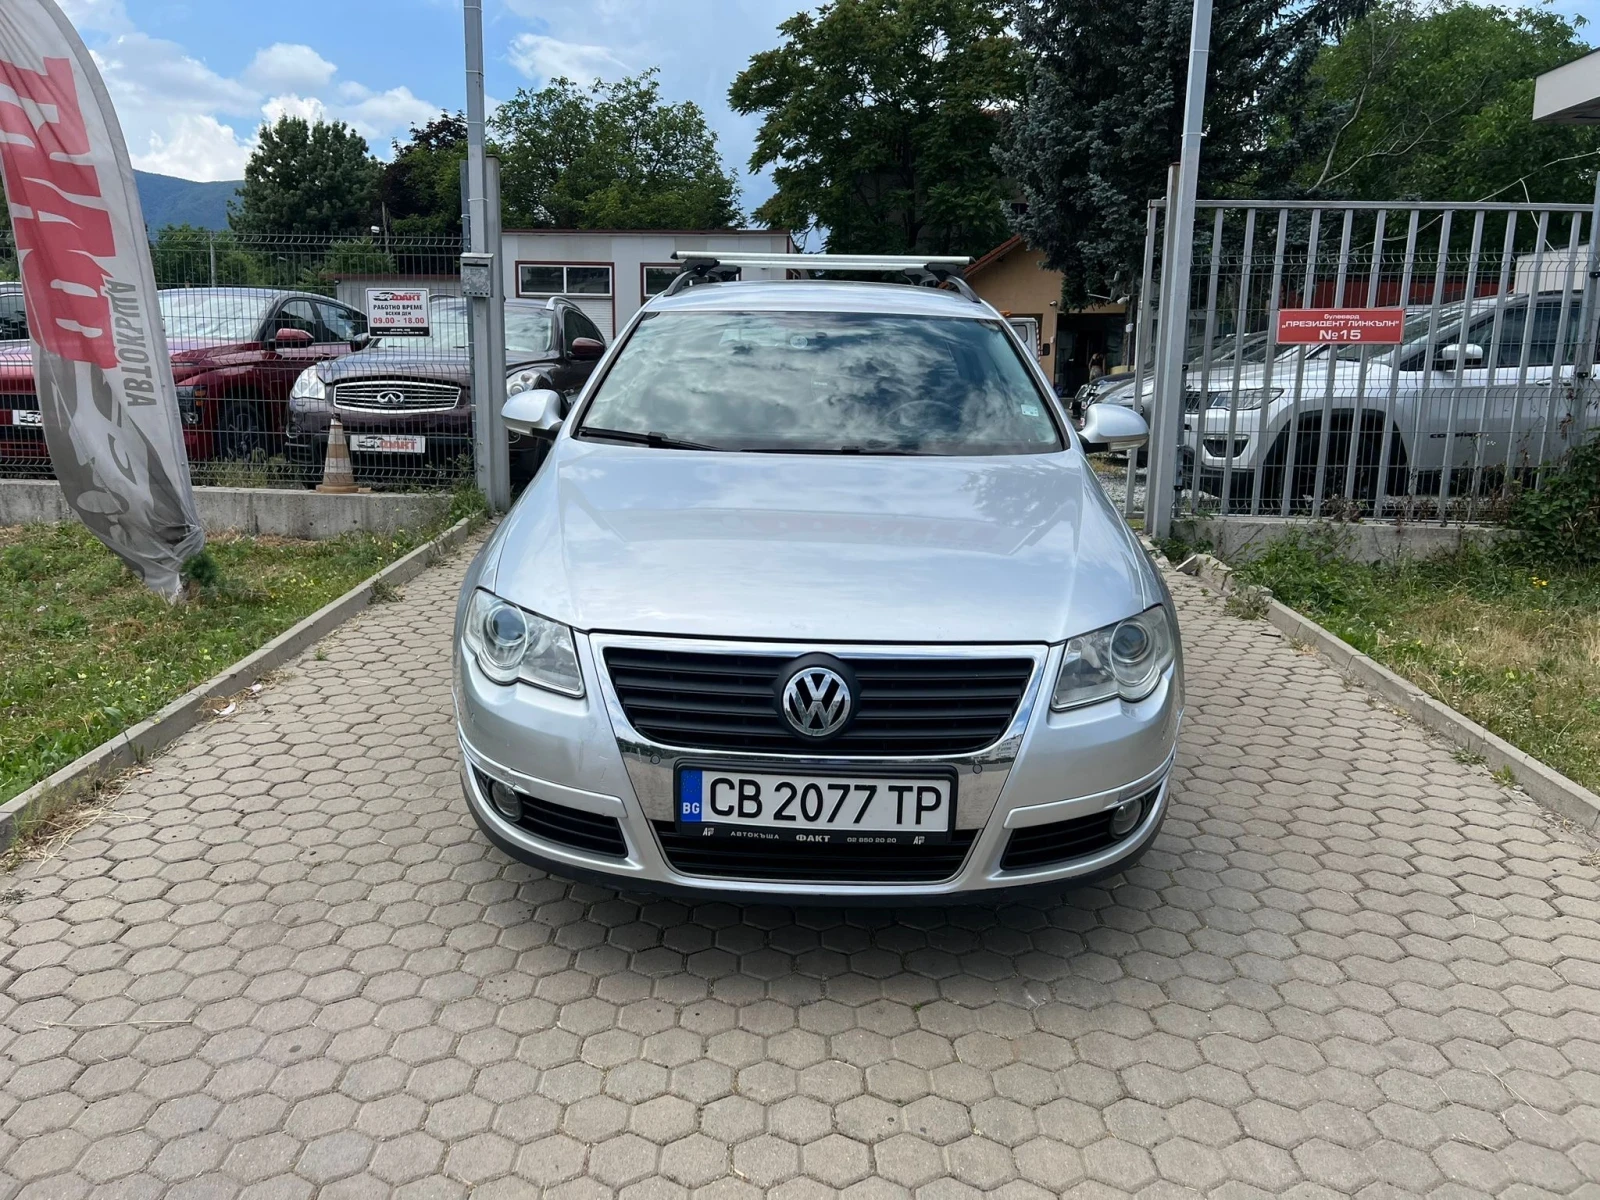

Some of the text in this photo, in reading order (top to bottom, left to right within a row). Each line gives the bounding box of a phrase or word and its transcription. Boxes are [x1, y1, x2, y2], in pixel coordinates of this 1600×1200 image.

[682, 802, 700, 814] BG
[773, 782, 877, 824] 2077
[796, 835, 831, 843] ФАКТ
